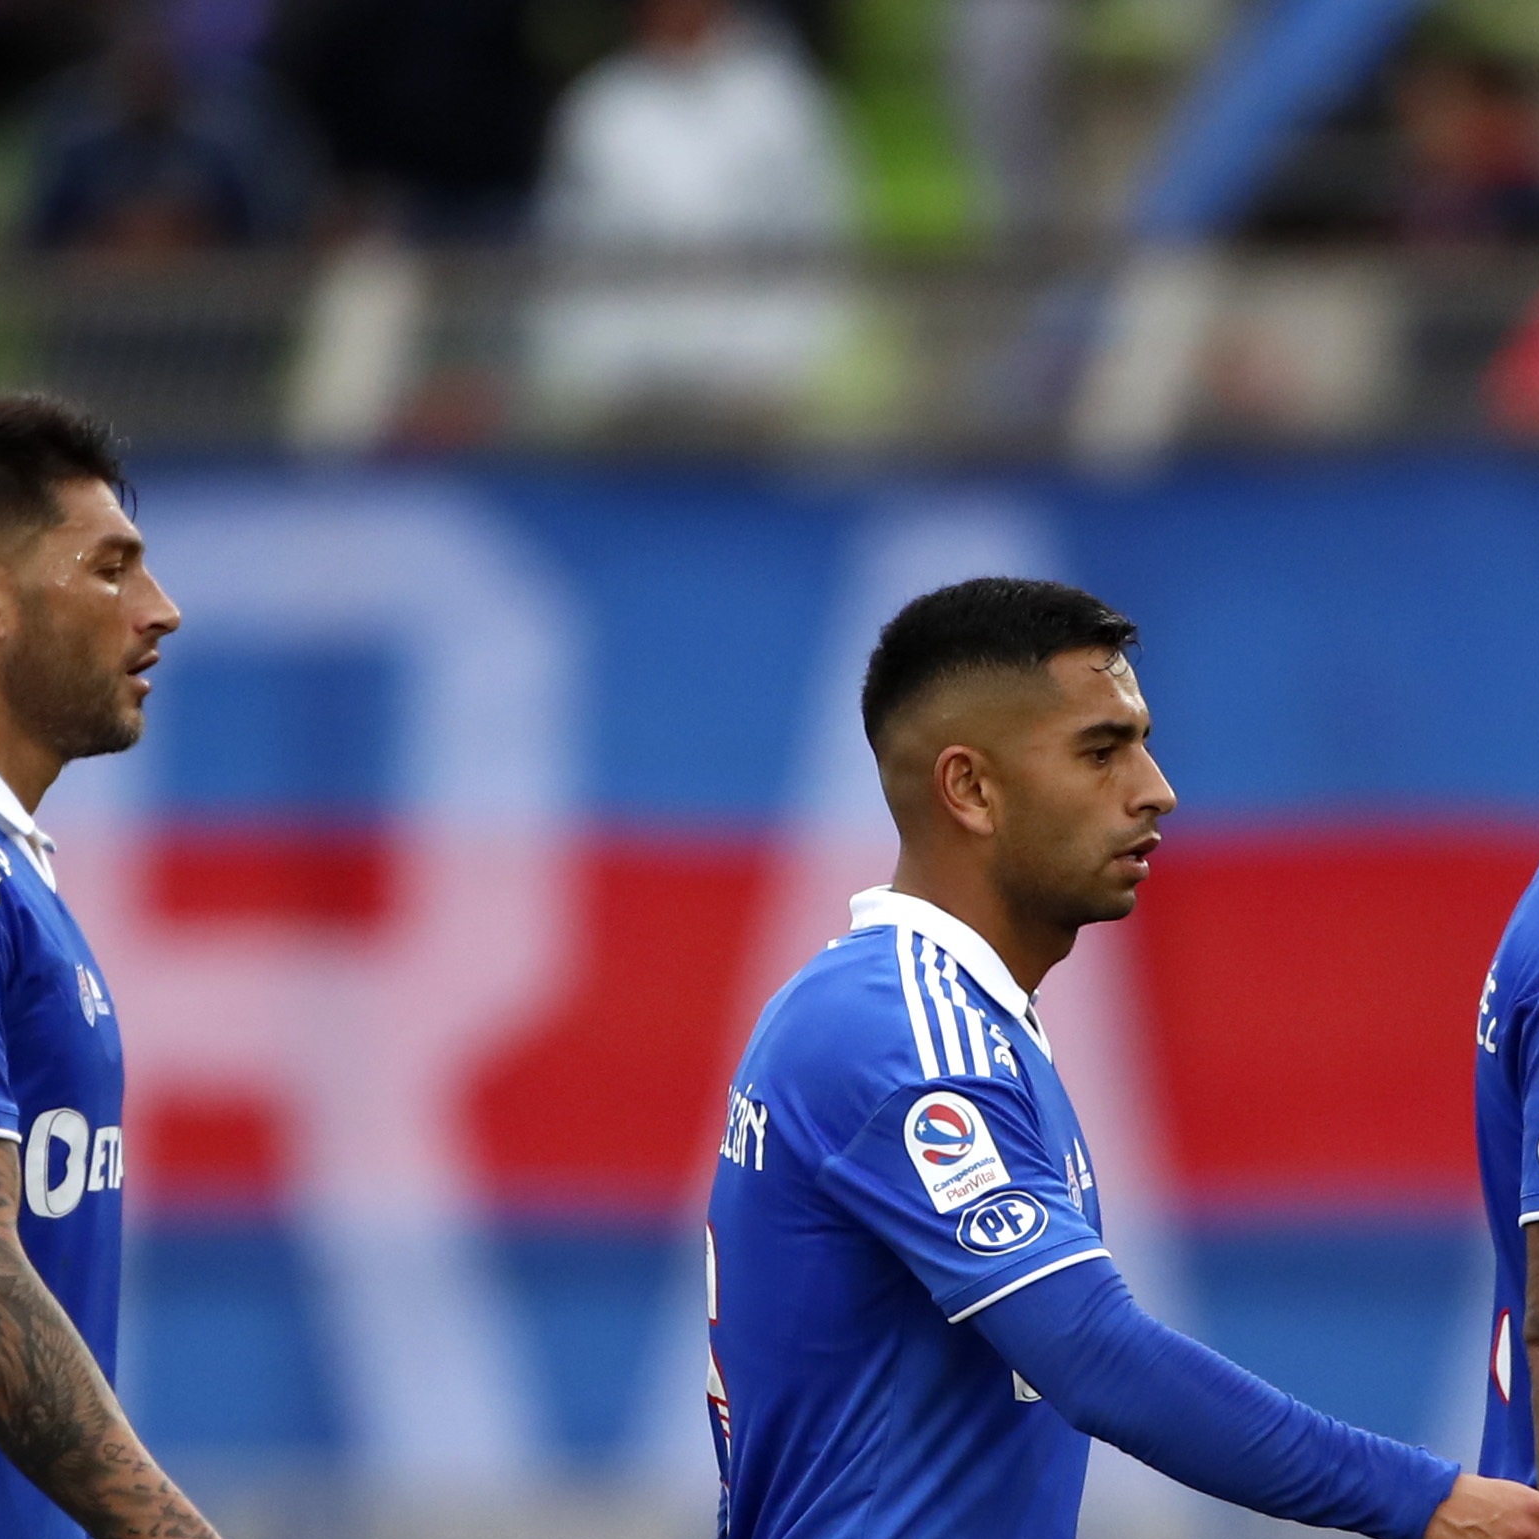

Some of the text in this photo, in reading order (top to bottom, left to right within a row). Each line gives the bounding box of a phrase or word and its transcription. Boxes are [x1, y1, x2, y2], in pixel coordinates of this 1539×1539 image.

[933, 1156, 996, 1193] Campeonato
[946, 1169, 997, 1203] PlanVital
[976, 1202, 1024, 1242] PF
